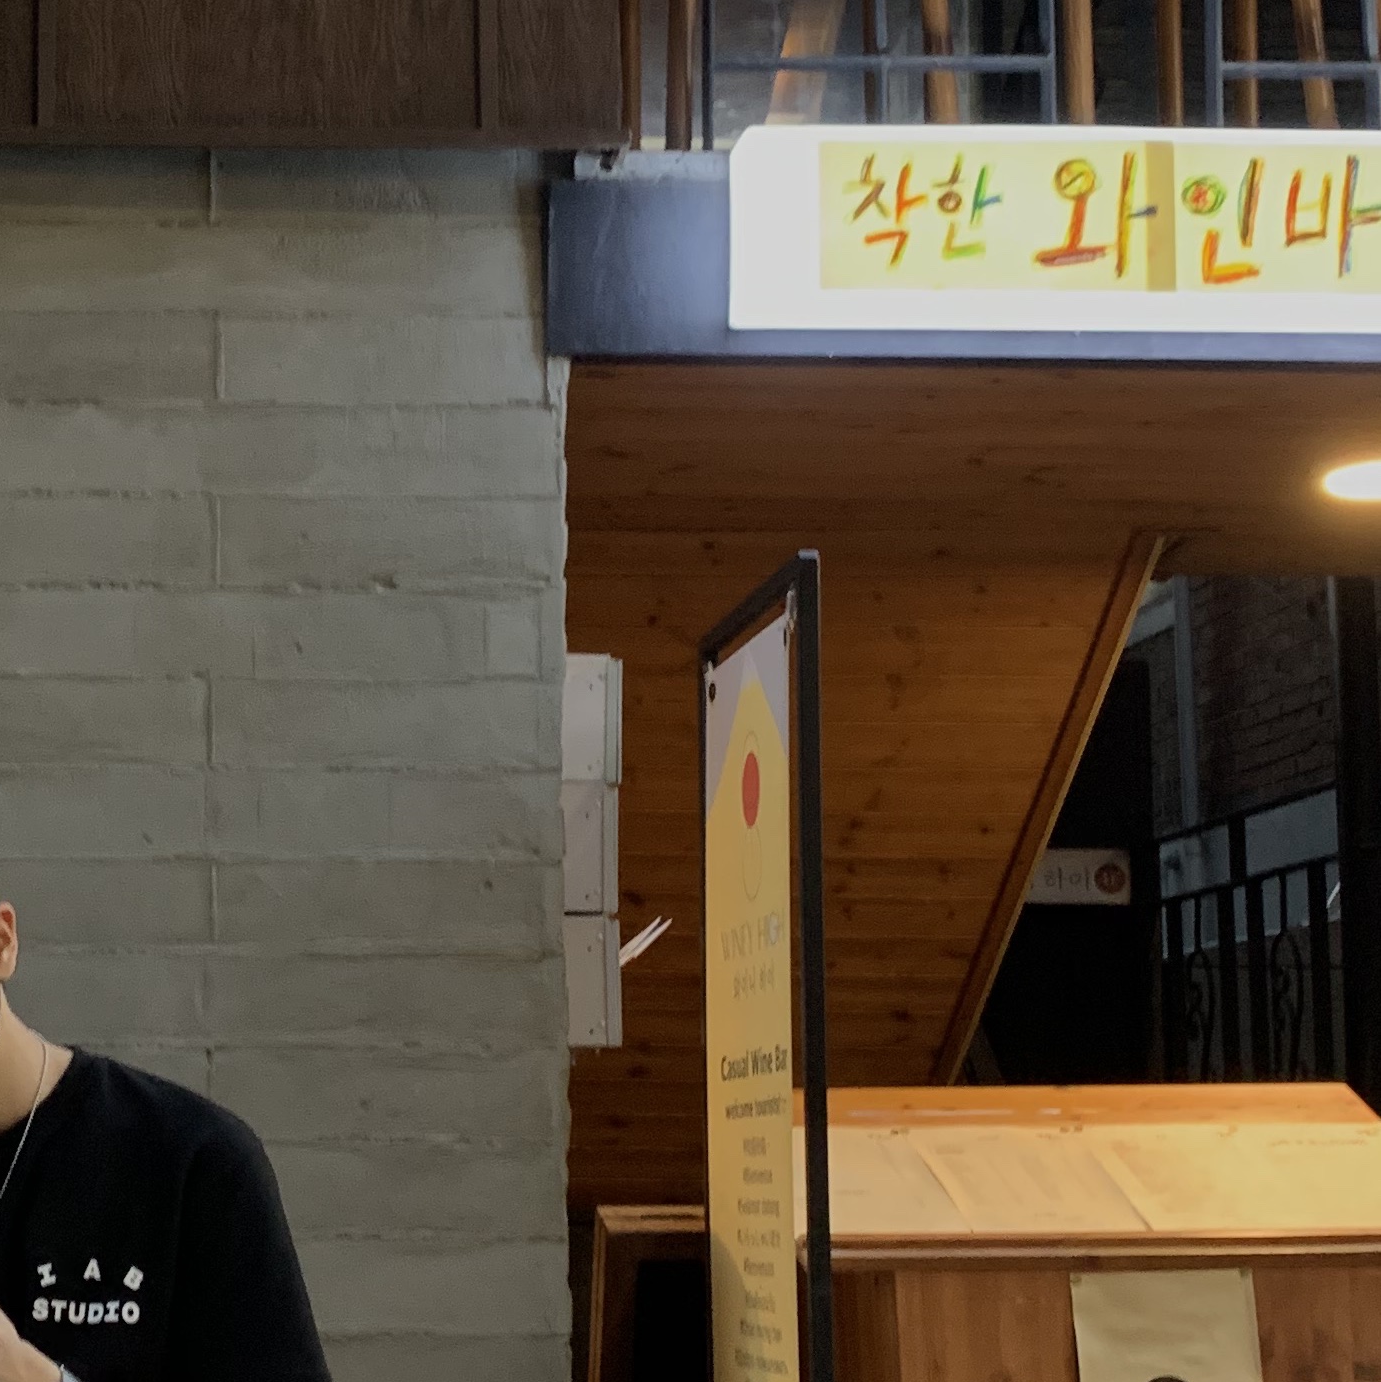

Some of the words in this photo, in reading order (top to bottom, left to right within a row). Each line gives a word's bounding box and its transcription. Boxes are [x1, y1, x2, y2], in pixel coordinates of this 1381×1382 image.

[843, 152, 1002, 270] 착한
[721, 1049, 749, 1082] Casual
[750, 1044, 773, 1077] Wine
[775, 1043, 788, 1072] Bar
[32, 1297, 141, 1325] STUDIO
